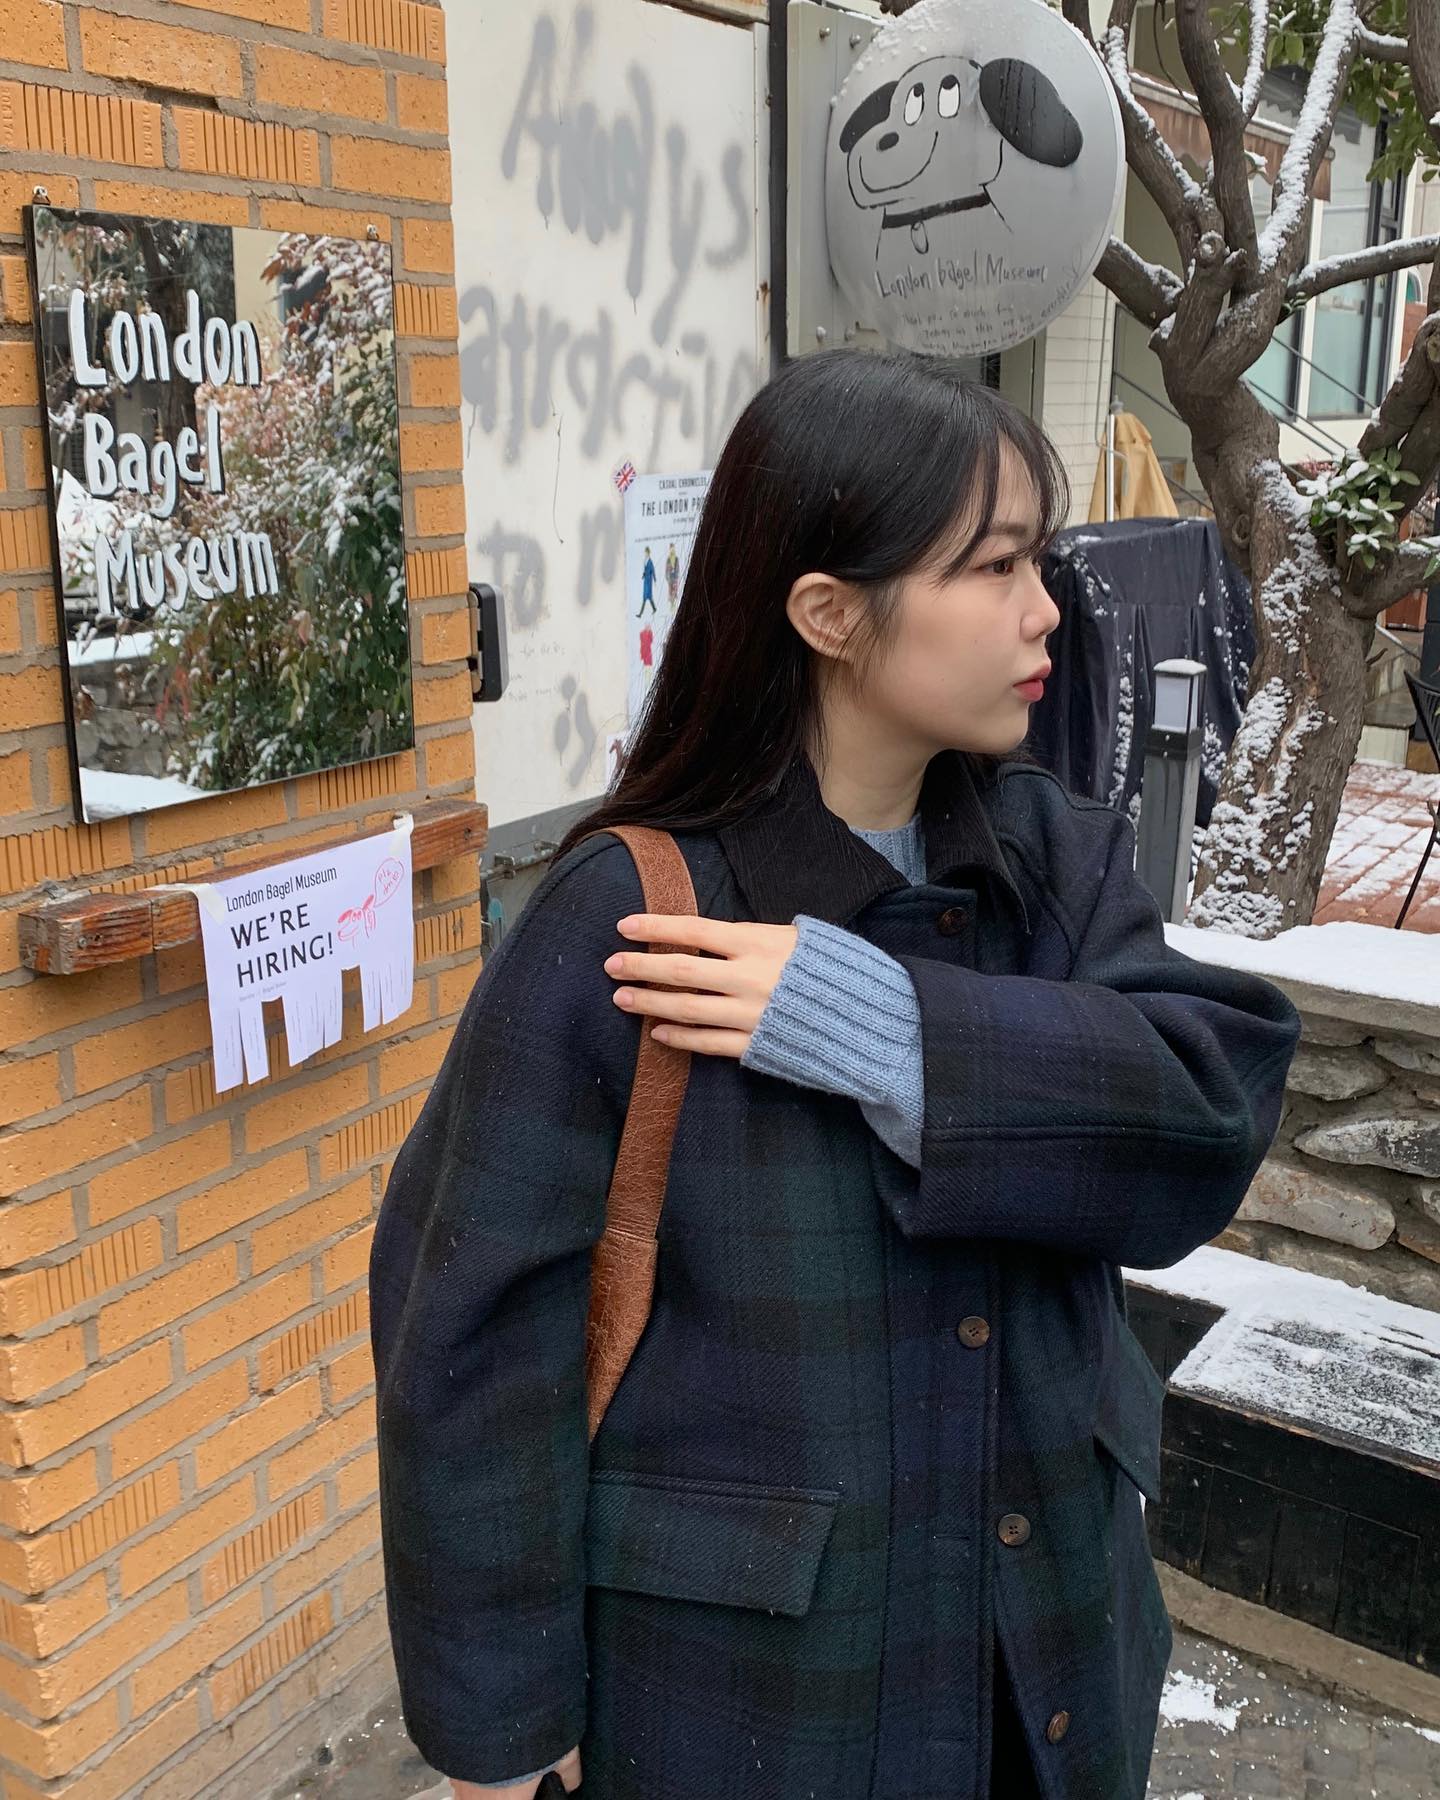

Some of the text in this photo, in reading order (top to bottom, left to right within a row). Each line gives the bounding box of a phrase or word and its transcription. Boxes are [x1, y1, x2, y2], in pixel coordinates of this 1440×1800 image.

[875, 265, 931, 299] London
[69, 288, 262, 388] London
[83, 401, 226, 519] Bagel
[642, 501, 656, 516] THE
[658, 498, 689, 515] LONDON
[94, 531, 279, 615] Museum
[226, 867, 338, 912] London Bagel Museum
[230, 903, 311, 950] WE'RE
[237, 931, 333, 988] HIRING!
